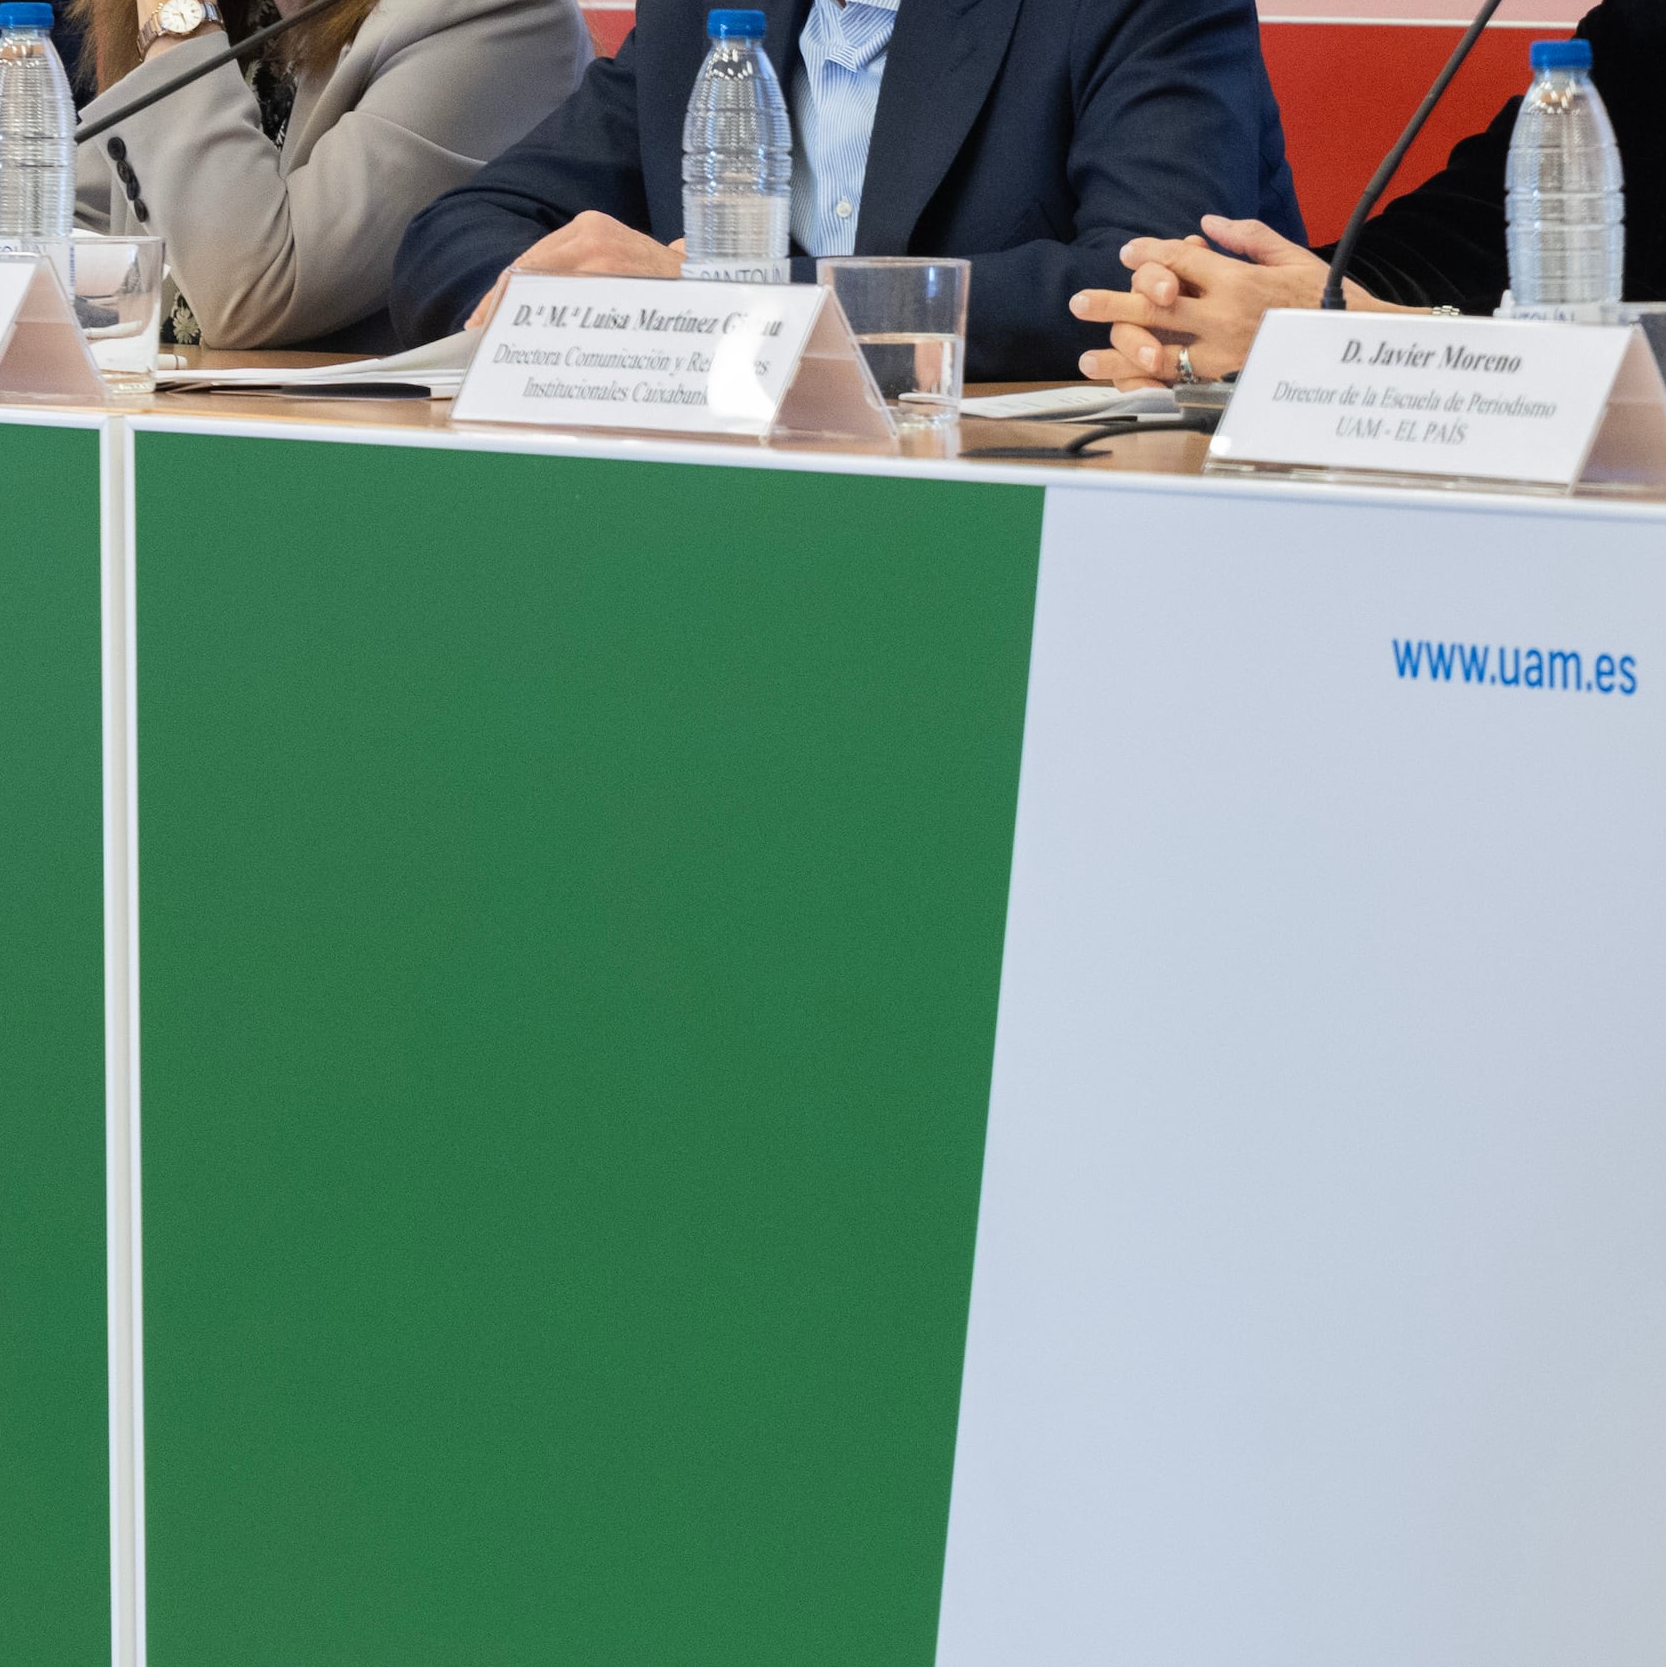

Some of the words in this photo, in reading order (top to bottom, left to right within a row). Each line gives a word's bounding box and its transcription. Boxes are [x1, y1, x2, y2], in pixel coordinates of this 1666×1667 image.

[582, 307, 630, 331] Luisa
[634, 308, 718, 334] Martínez
[493, 343, 561, 366] Directora
[564, 345, 669, 370] Comunicación
[669, 356, 682, 376] y
[1340, 339, 1363, 363] D.
[1368, 340, 1434, 368] Javier
[1437, 344, 1523, 373] Moreno
[522, 377, 629, 401] Institucionales
[1273, 380, 1337, 404] Director
[1339, 384, 1362, 406] de
[1362, 386, 1376, 406] la
[1382, 387, 1439, 412] Escuela
[1443, 391, 1465, 413] de
[1466, 392, 1557, 419] Periodismo
[1334, 415, 1381, 438] UAM
[1394, 420, 1418, 442] EL
[1422, 416, 1469, 445] PAÍS
[1391, 638, 1637, 696] www.uam.es
